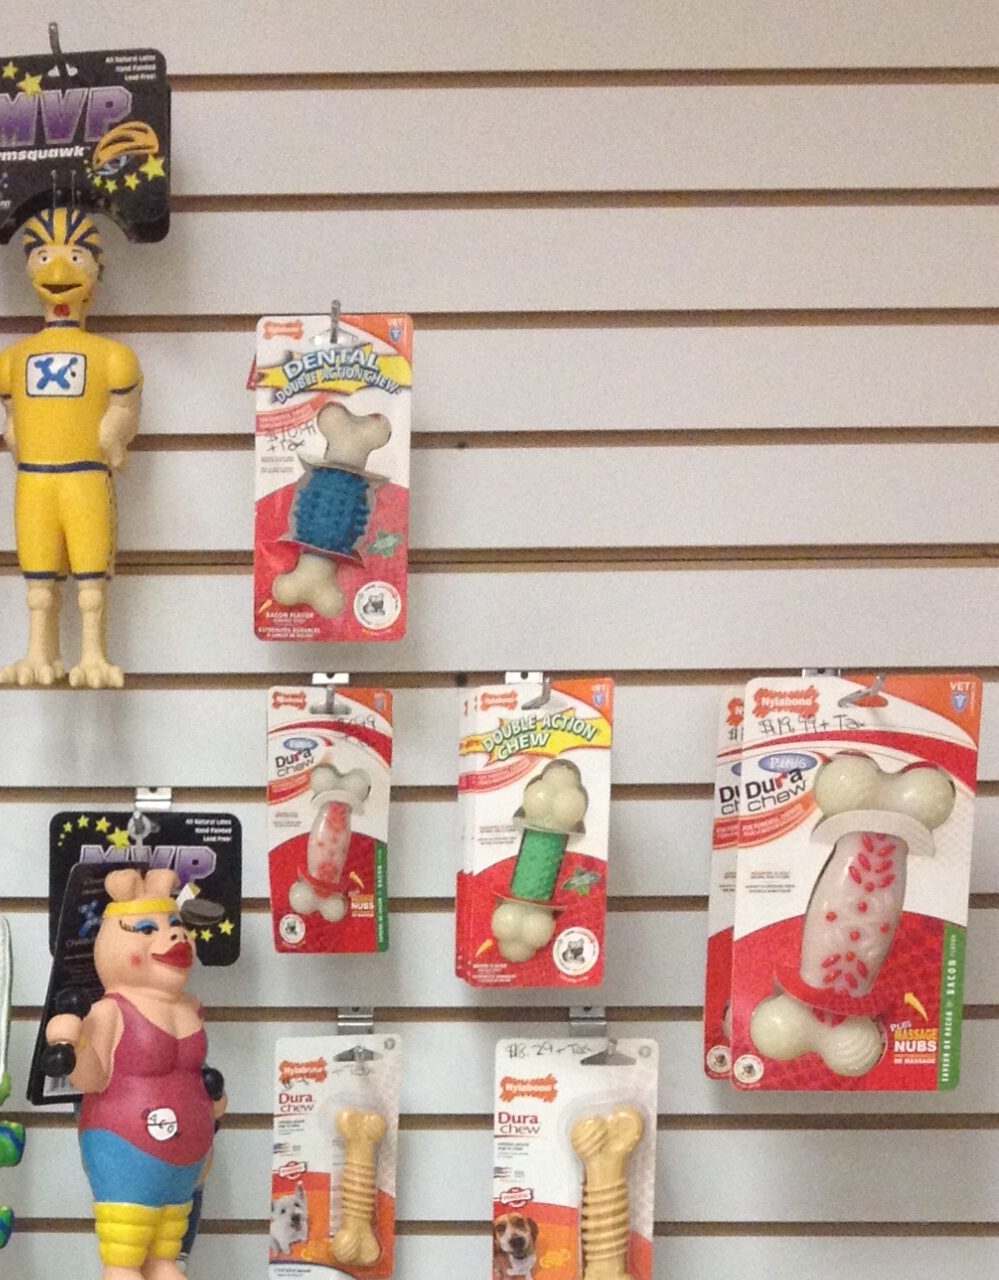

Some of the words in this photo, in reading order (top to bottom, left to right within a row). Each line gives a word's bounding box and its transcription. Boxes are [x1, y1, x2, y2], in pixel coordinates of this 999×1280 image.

[284, 349, 380, 379] DENTAL
[275, 372, 319, 404] DOUBLE
[321, 367, 365, 383] ACTION
[363, 369, 400, 395] CHEW
[951, 681, 971, 690] VET
[482, 715, 537, 751] DOUBLE
[542, 712, 596, 741] ACTION
[497, 733, 550, 761] CHEW
[275, 748, 312, 769] Dura
[276, 757, 315, 778] chew
[745, 768, 804, 799] Dura
[747, 778, 807, 812] chew
[946, 960, 956, 995] BACON
[894, 1040, 937, 1052] NUBS
[279, 1093, 313, 1104] Dura
[280, 1103, 315, 1113] chew
[498, 1111, 539, 1124] Dura
[500, 1124, 540, 1135] chew
